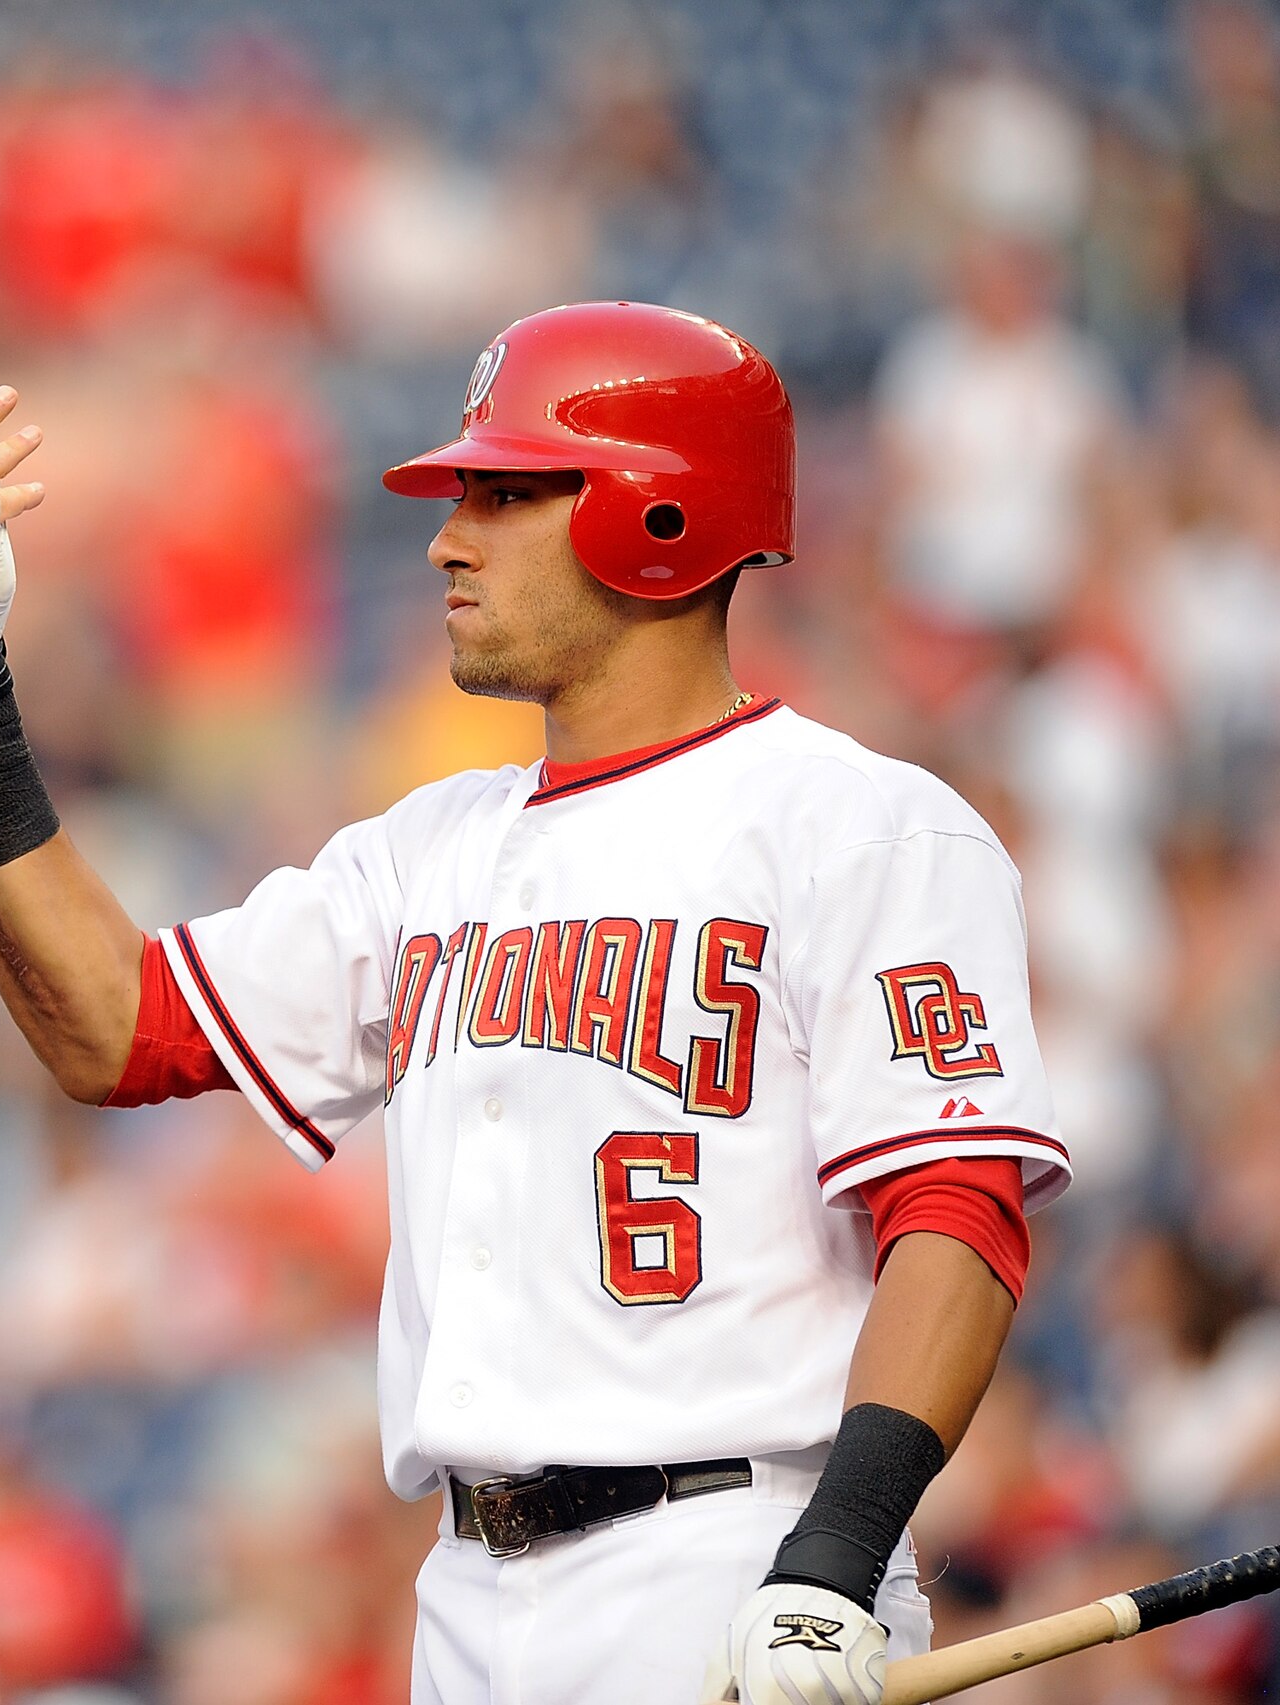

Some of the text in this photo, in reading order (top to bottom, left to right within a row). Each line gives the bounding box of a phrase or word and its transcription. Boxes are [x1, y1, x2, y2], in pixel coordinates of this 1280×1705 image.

[384, 918, 769, 1118] ATIONALS
[875, 962, 1003, 1081] DC
[594, 1131, 702, 1307] 6
